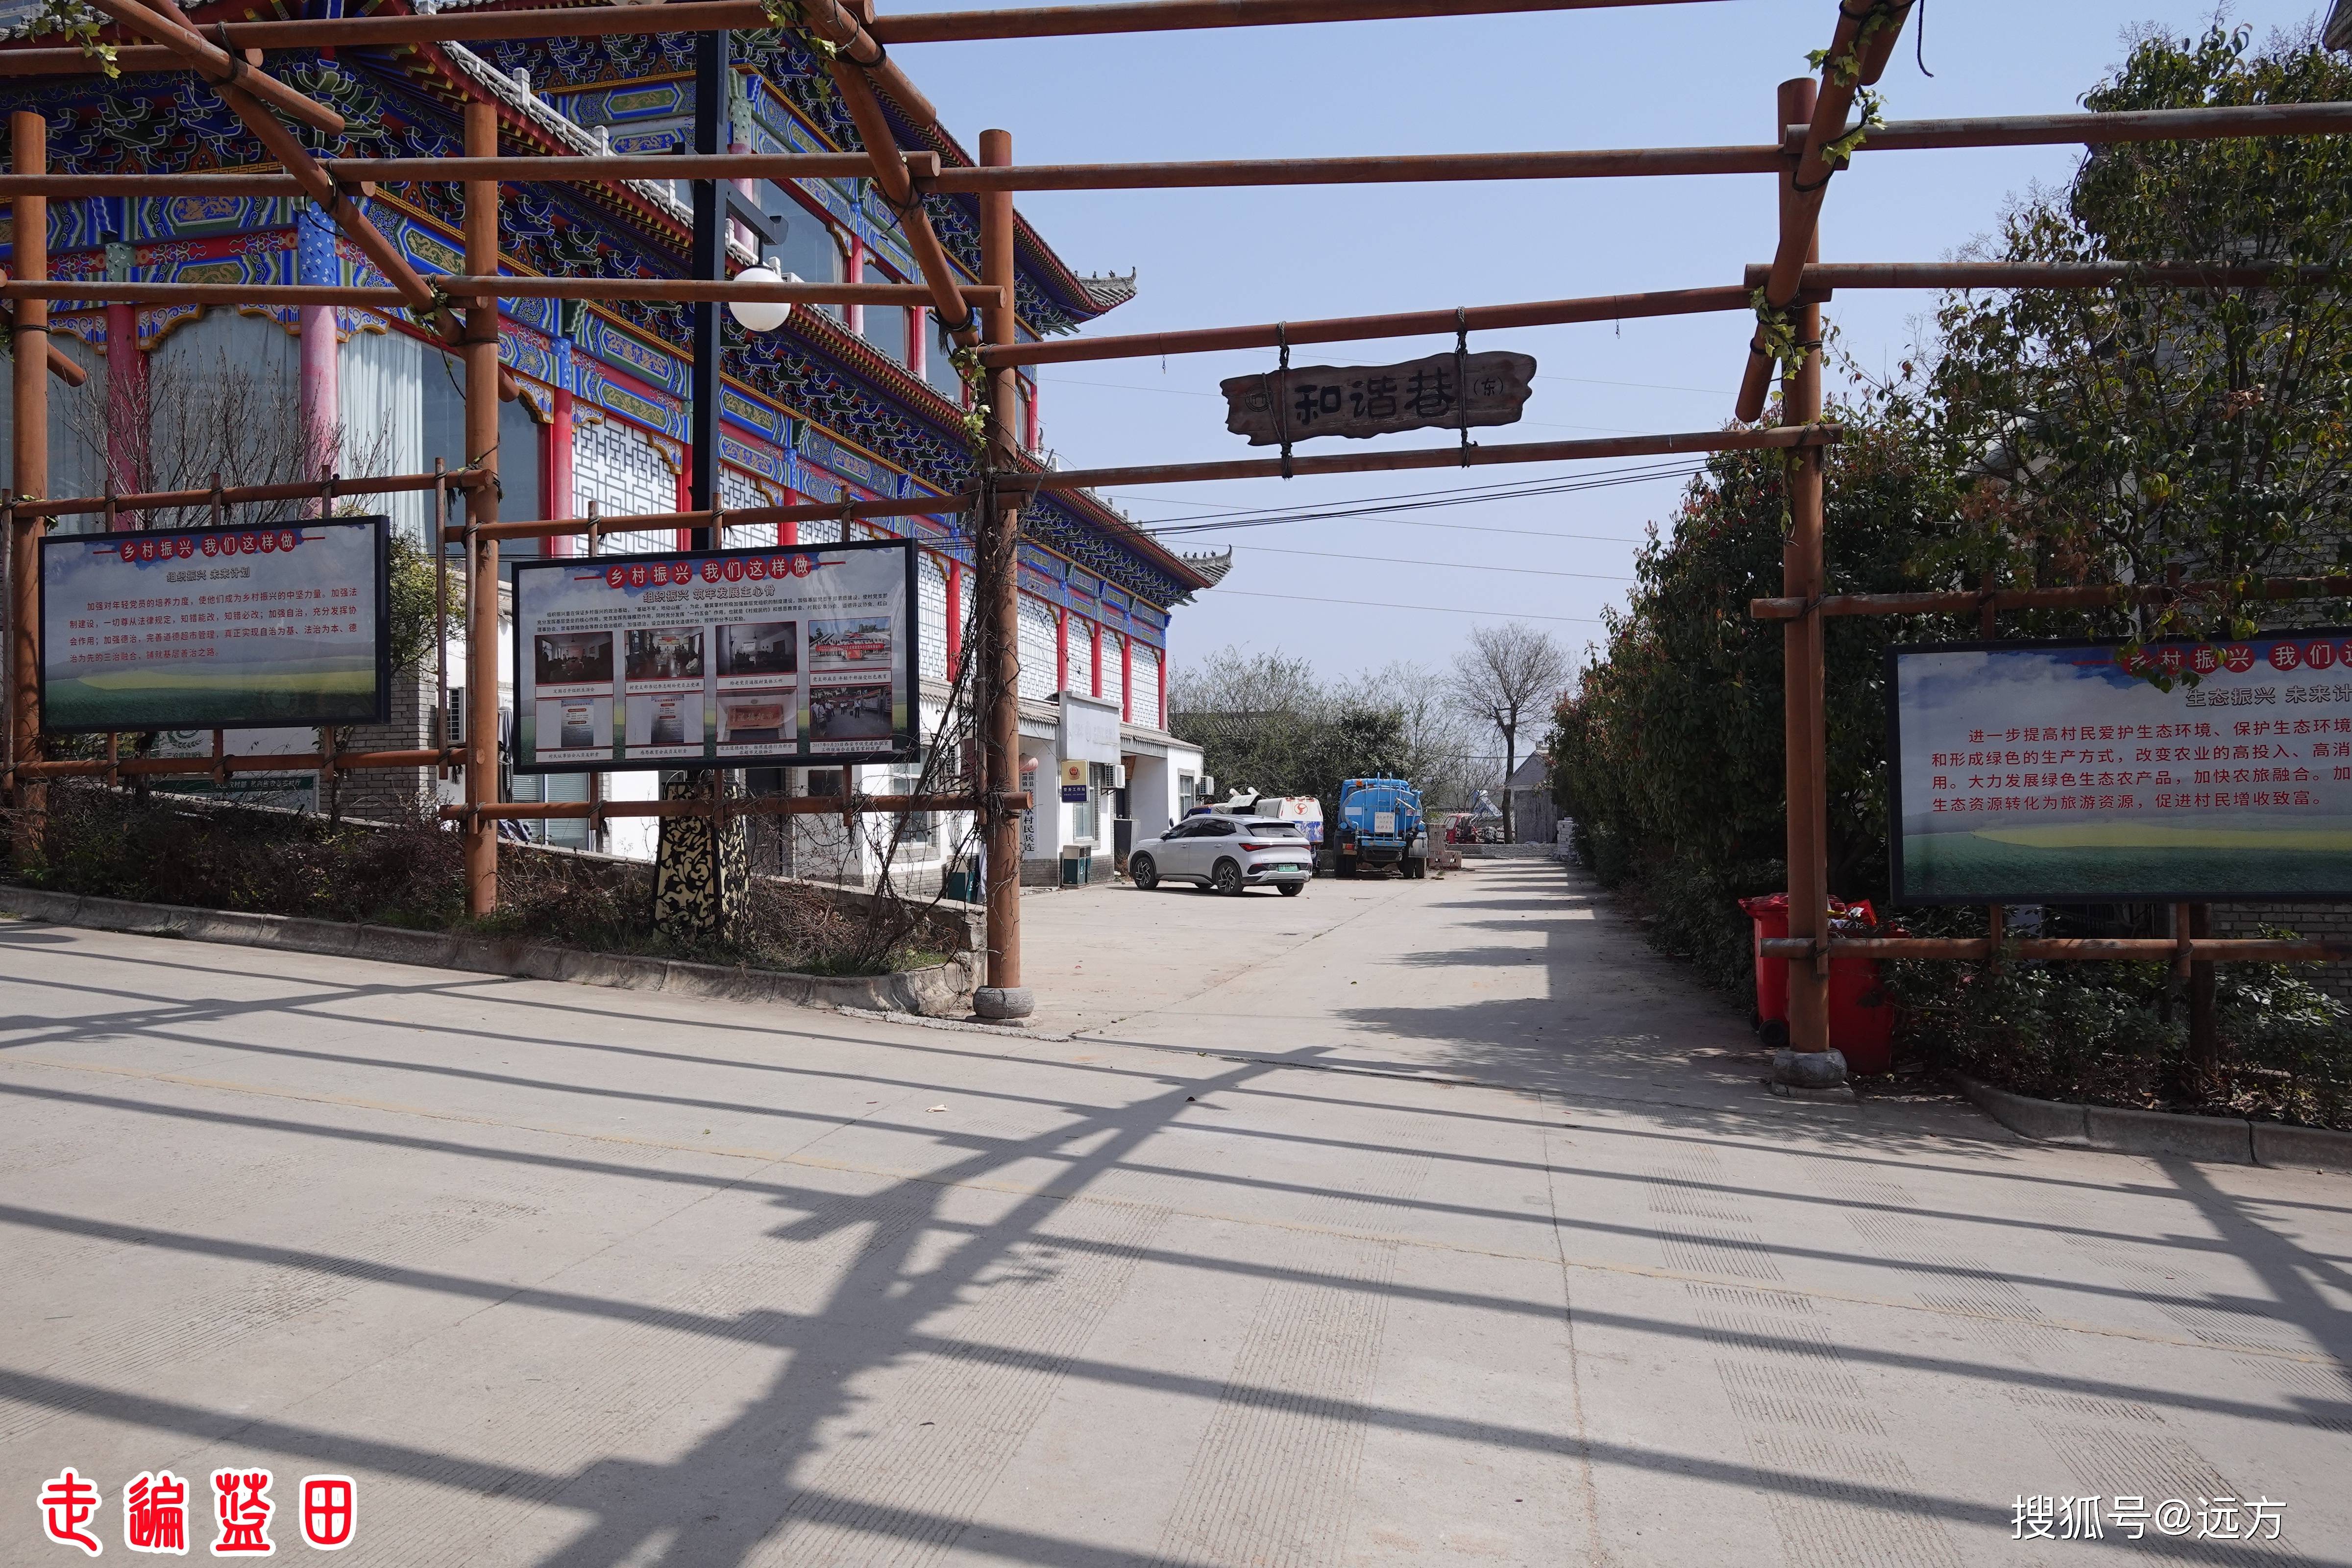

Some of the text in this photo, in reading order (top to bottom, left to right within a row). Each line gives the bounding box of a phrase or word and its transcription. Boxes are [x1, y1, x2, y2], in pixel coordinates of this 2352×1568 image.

[1295, 367, 1456, 425] 和谐巷
[124, 533, 293, 559] 乡村振兴 我们这样做
[167, 566, 250, 583] 组织振兴 未来计划
[612, 557, 808, 585] 乡村振兴 我们这样做
[643, 585, 775, 603] 组织振兴 筑牢发展主心骨
[2186, 686, 2275, 707] 生态振兴
[1969, 718, 2351, 743] 进一步提高村民爱护生态环境、保护生态环境
[1932, 741, 2350, 767] 和形成绿色的生产方式，改变农业的高投入、高消
[1932, 765, 2351, 790] 用。大力发展绿色生态农产品，加快农旅融合。加
[1933, 789, 2320, 812] 生态资源转化为旅游资源，促进村民增收致富。
